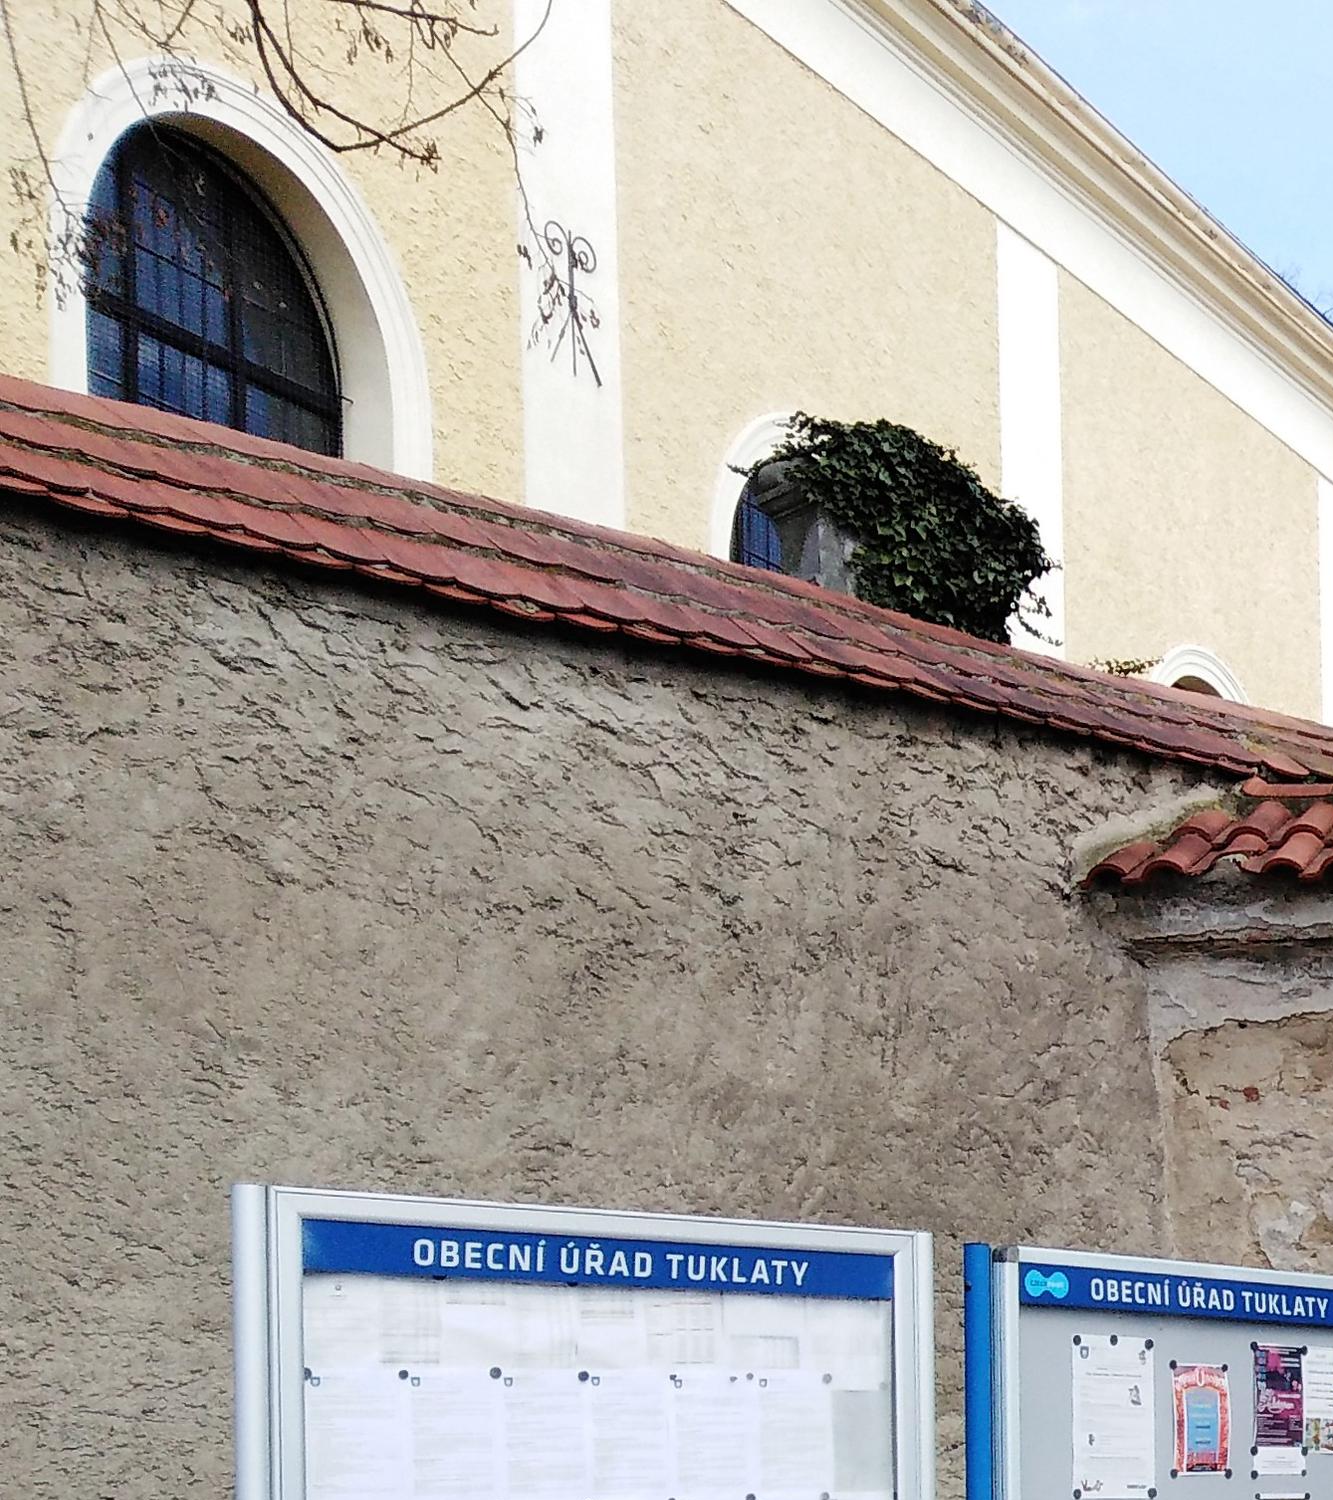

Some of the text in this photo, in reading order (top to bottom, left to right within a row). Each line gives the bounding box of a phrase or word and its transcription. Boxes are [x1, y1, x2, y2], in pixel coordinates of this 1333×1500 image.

[413, 1238, 809, 1286] OBECNÍ ÚŘAD TUKLATY
[1090, 1278, 1329, 1318] OBECNÍ ÚŘAD TUKLATY
